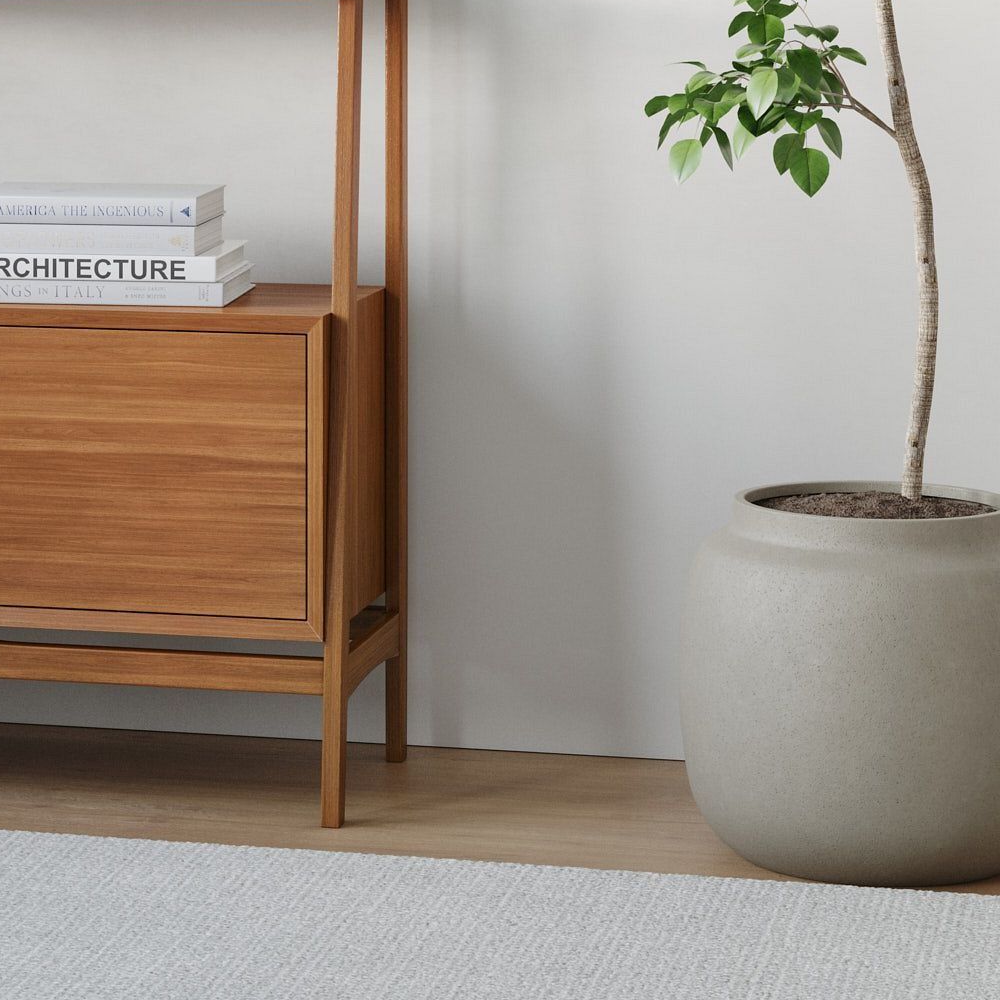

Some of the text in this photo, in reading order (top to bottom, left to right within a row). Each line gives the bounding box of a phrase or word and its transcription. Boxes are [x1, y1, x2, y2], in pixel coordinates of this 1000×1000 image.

[61, 205, 88, 217] THE
[92, 205, 165, 217] INGENIOUS
[38, 287, 49, 295] IN
[55, 285, 105, 298] ITALY
